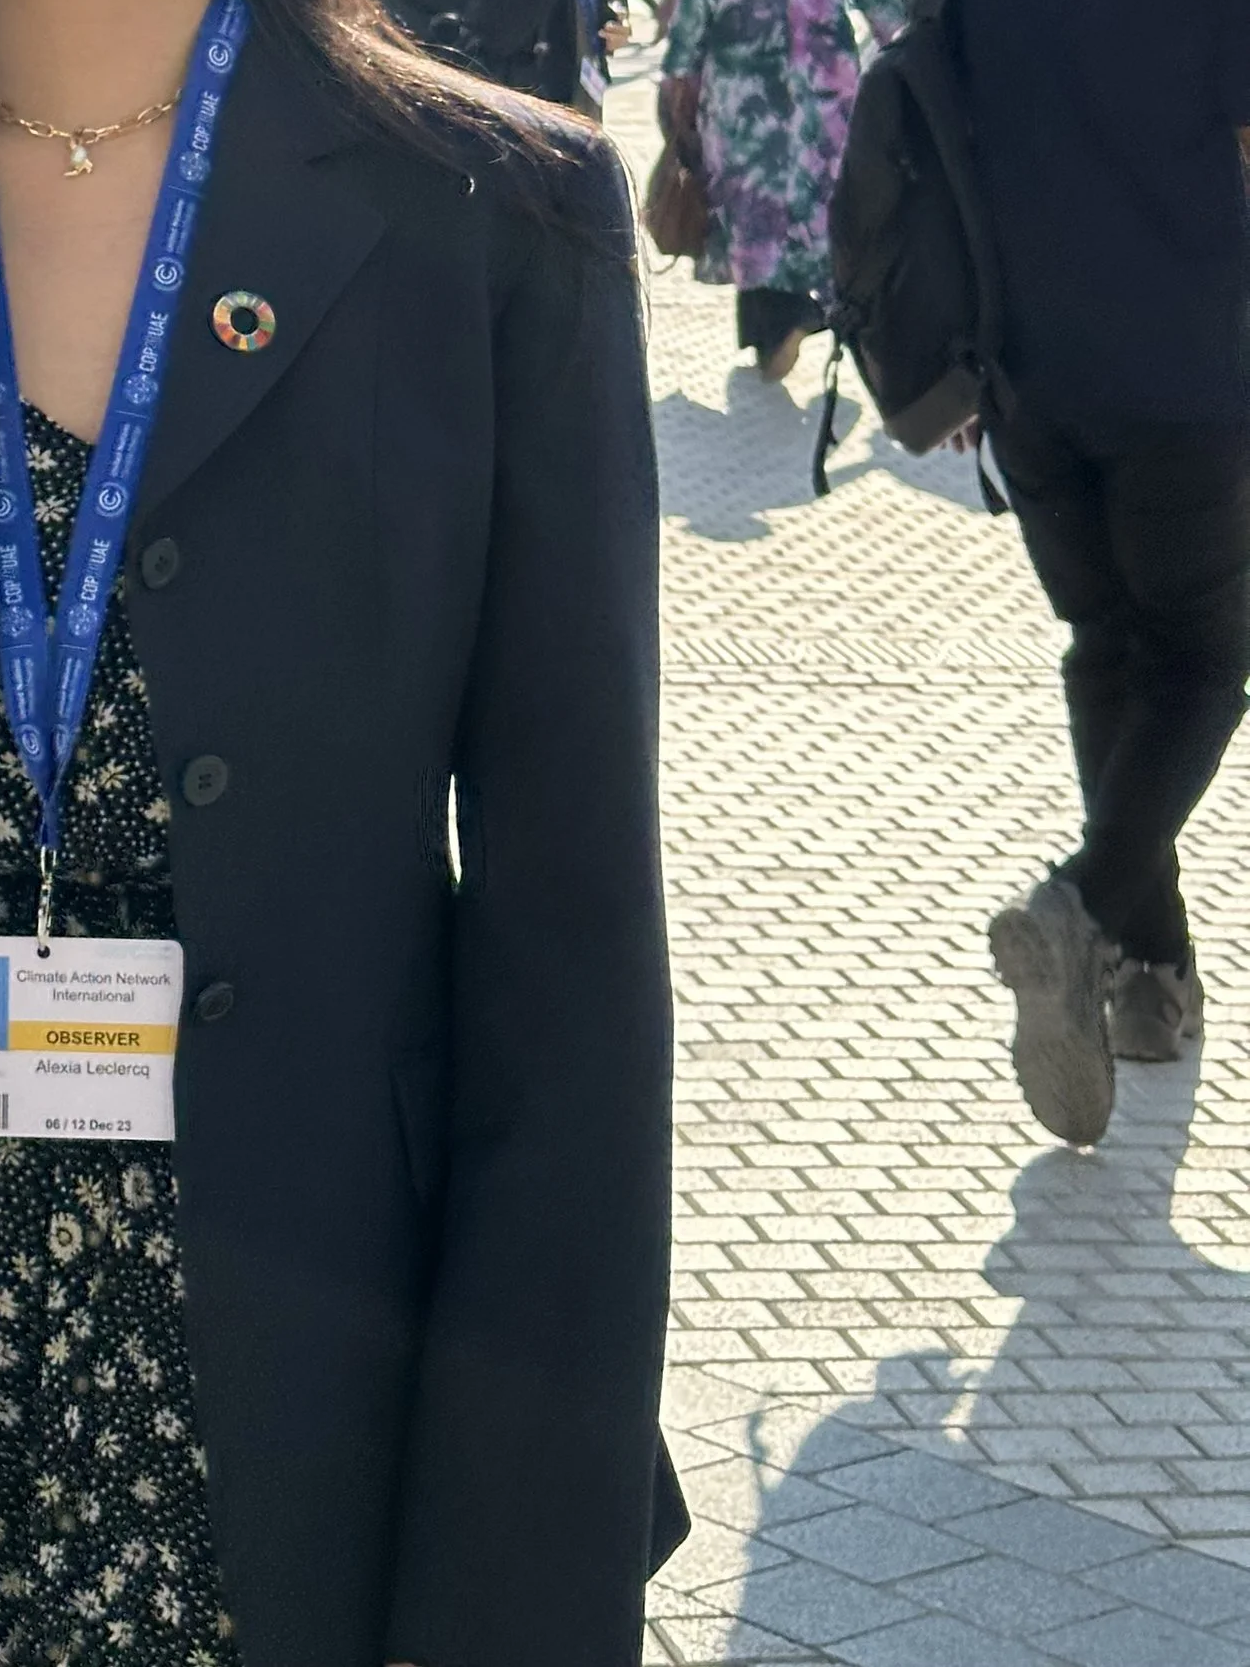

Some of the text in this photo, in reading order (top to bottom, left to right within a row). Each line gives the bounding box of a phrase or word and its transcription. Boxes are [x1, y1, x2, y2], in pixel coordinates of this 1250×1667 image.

[148, 311, 169, 337] UAE
[90, 538, 110, 564] UAE
[16, 969, 171, 986] Climate Action Network
[52, 989, 136, 1003] International
[46, 1030, 140, 1046] OBSERVER
[35, 1059, 150, 1079] Alexia Leclercq
[45, 1118, 61, 1130] 06
[72, 1119, 86, 1131] 12
[89, 1119, 114, 1131] Dec
[117, 1120, 132, 1132] 23
